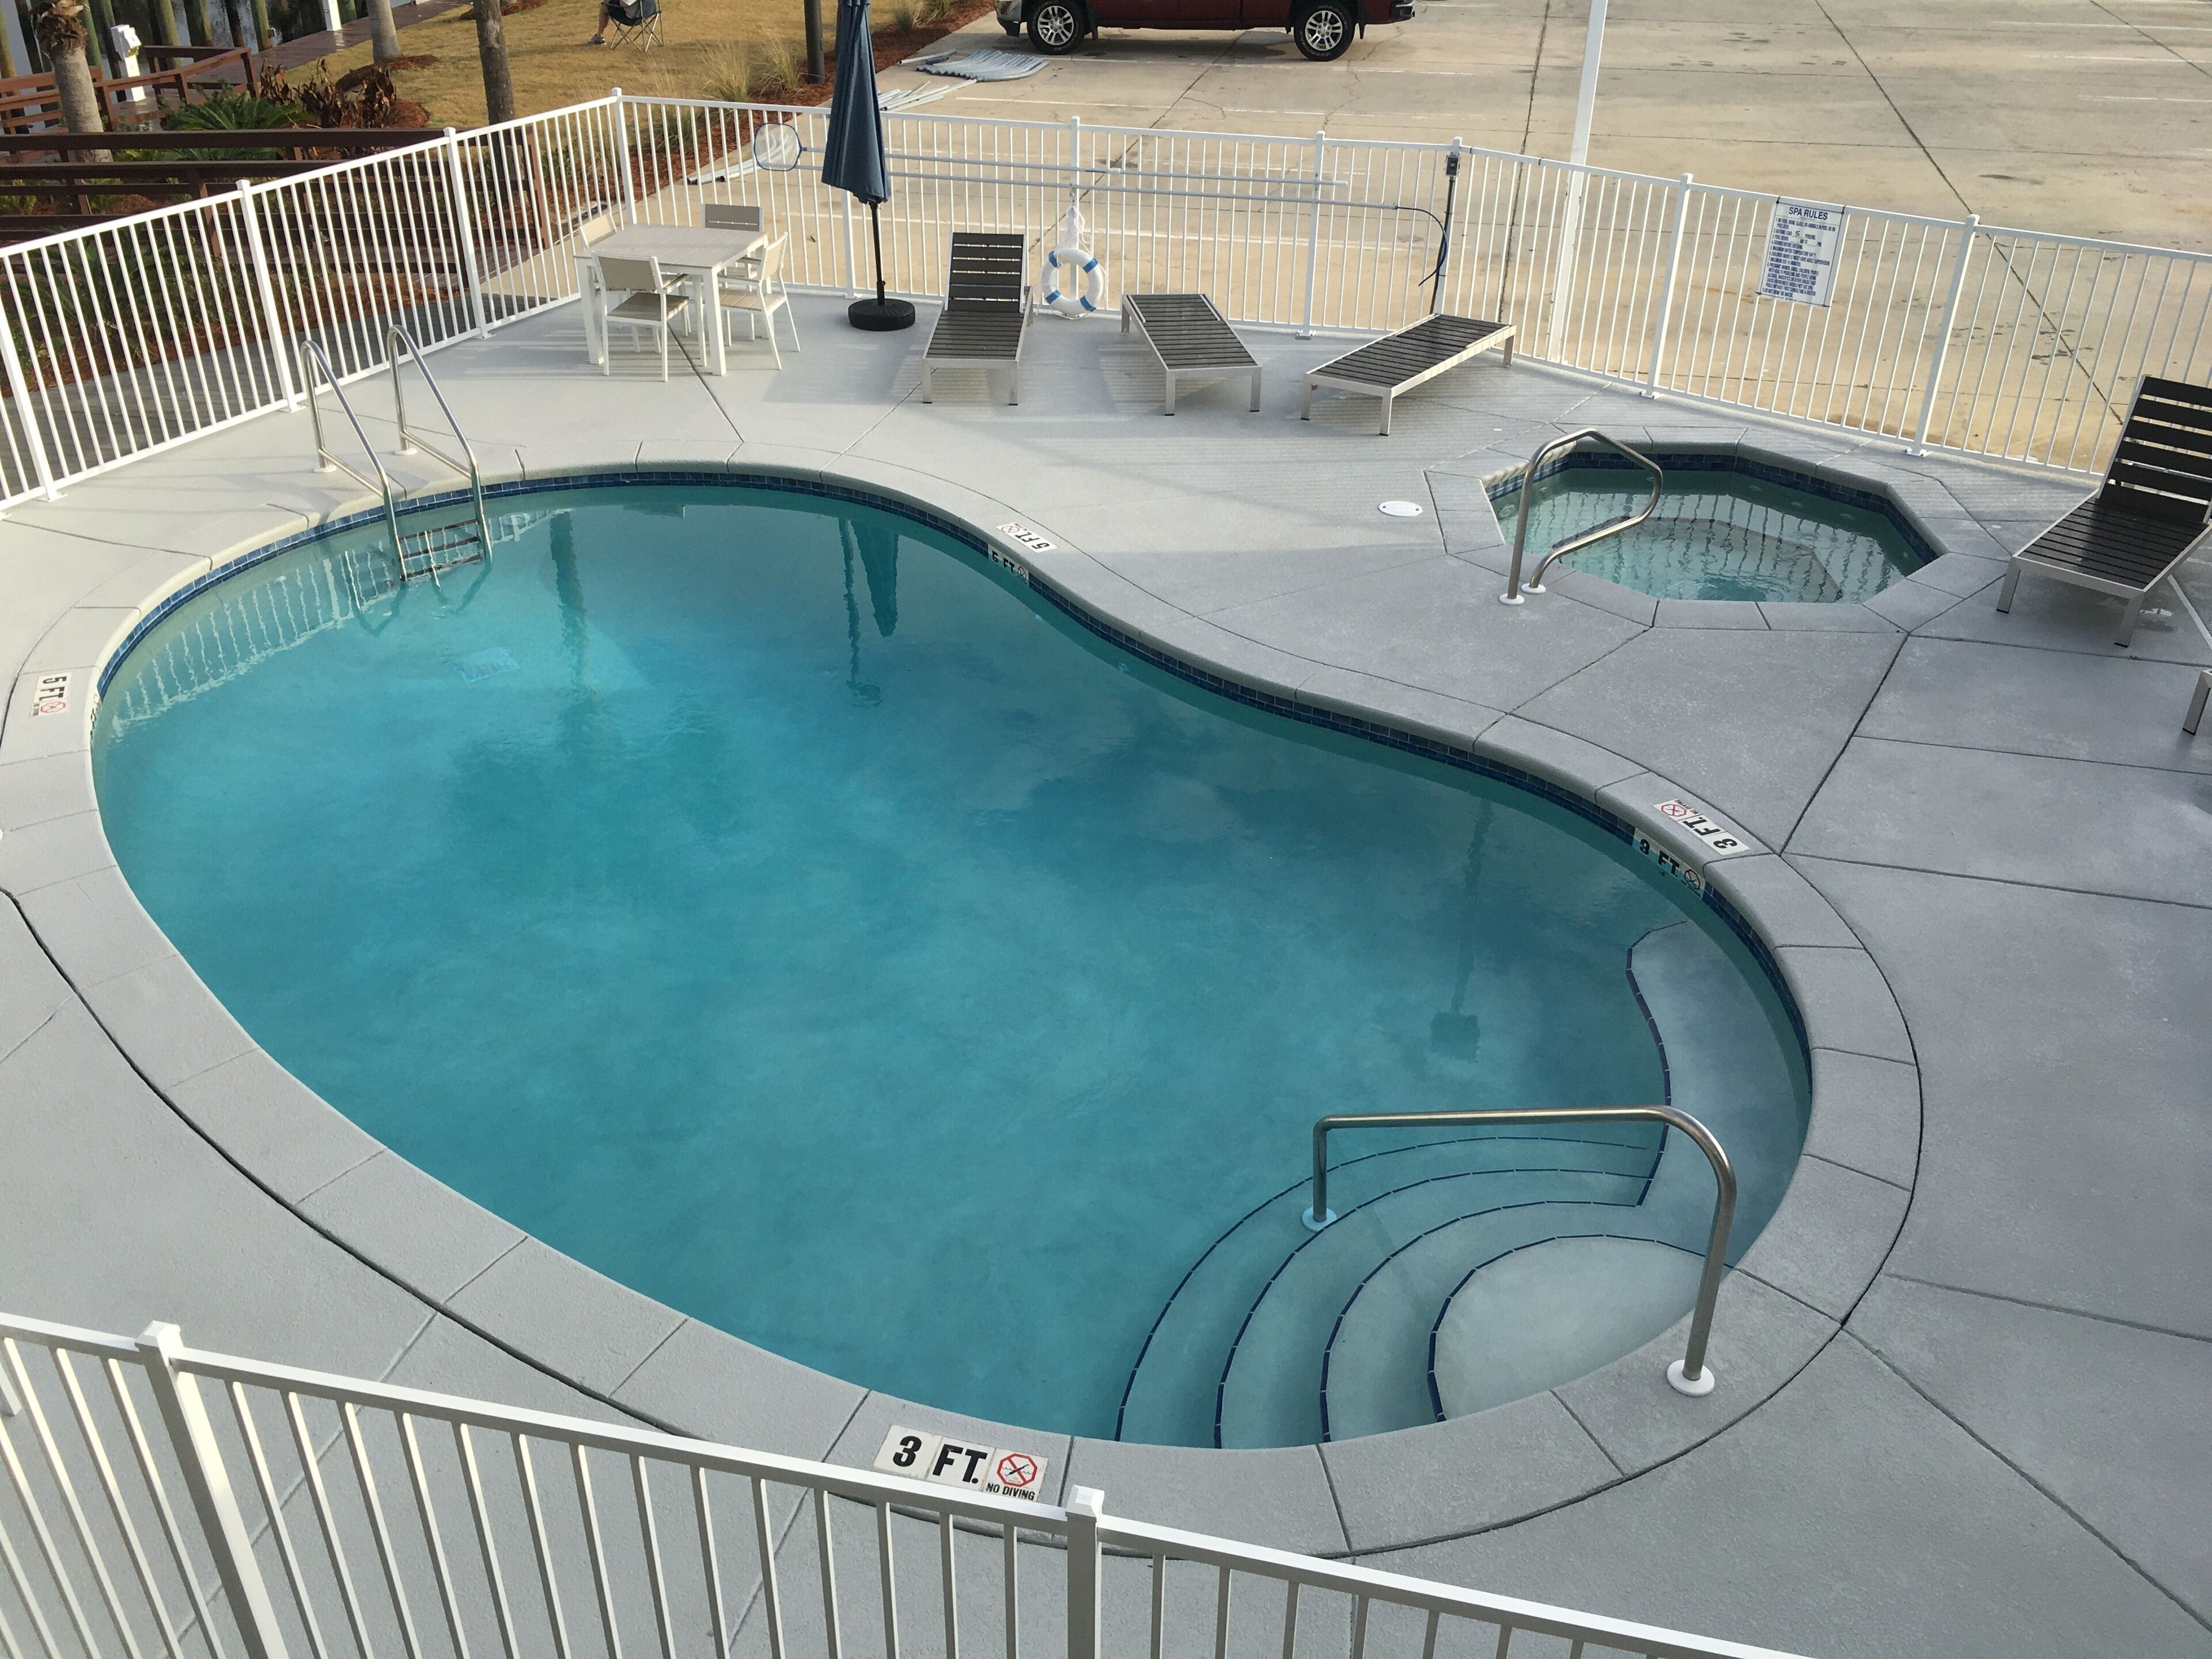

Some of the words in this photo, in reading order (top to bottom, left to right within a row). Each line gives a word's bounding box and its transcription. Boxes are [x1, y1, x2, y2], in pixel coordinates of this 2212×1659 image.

[1789, 207, 1803, 217] SPA
[1804, 209, 1828, 220] RULES
[42, 676, 67, 684] 5
[1682, 816, 1721, 836] FT.
[1713, 838, 1738, 849] 3
[892, 1435, 922, 1467] 3
[932, 1443, 988, 1484] FT.
[986, 1482, 1001, 1493] NO
[1002, 1485, 1036, 1501] DIVING
